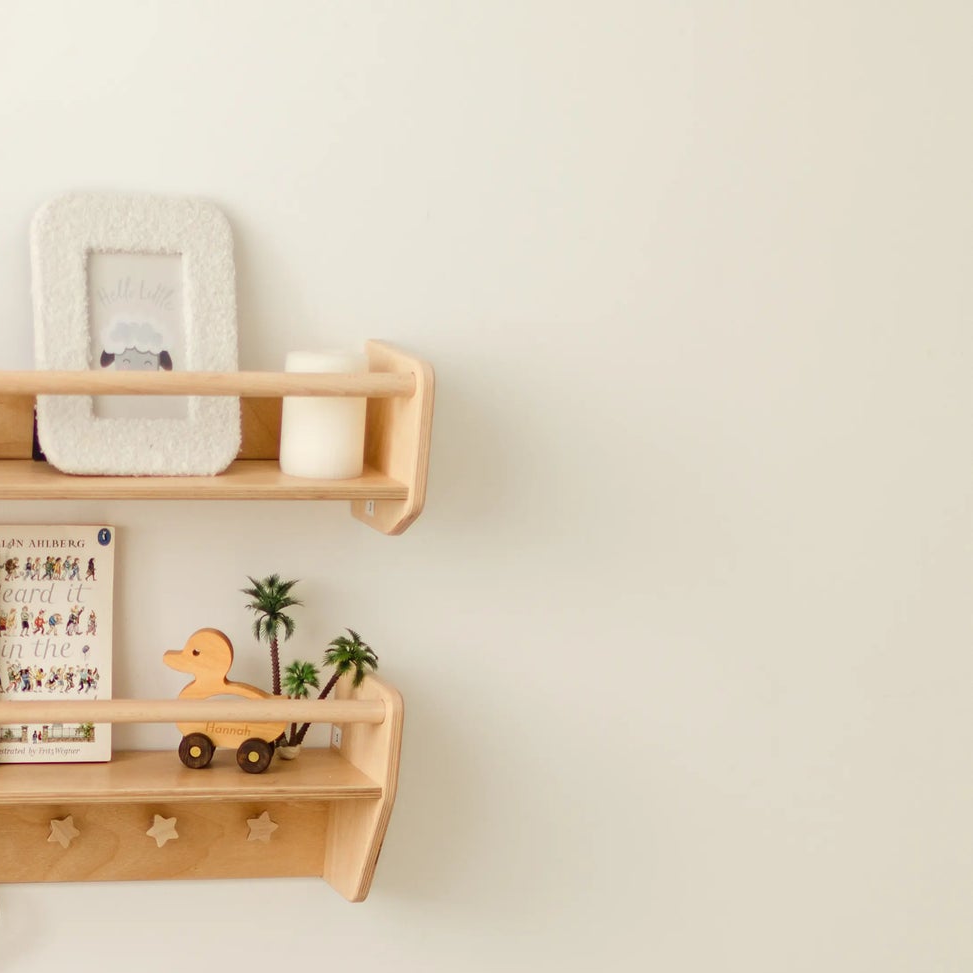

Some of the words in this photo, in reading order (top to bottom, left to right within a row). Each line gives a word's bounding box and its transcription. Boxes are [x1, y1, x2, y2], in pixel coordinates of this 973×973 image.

[28, 539, 85, 548] AHLBERG
[67, 583, 92, 603] it
[1, 640, 23, 659] in
[30, 638, 72, 659] the
[205, 720, 252, 736] Hannah
